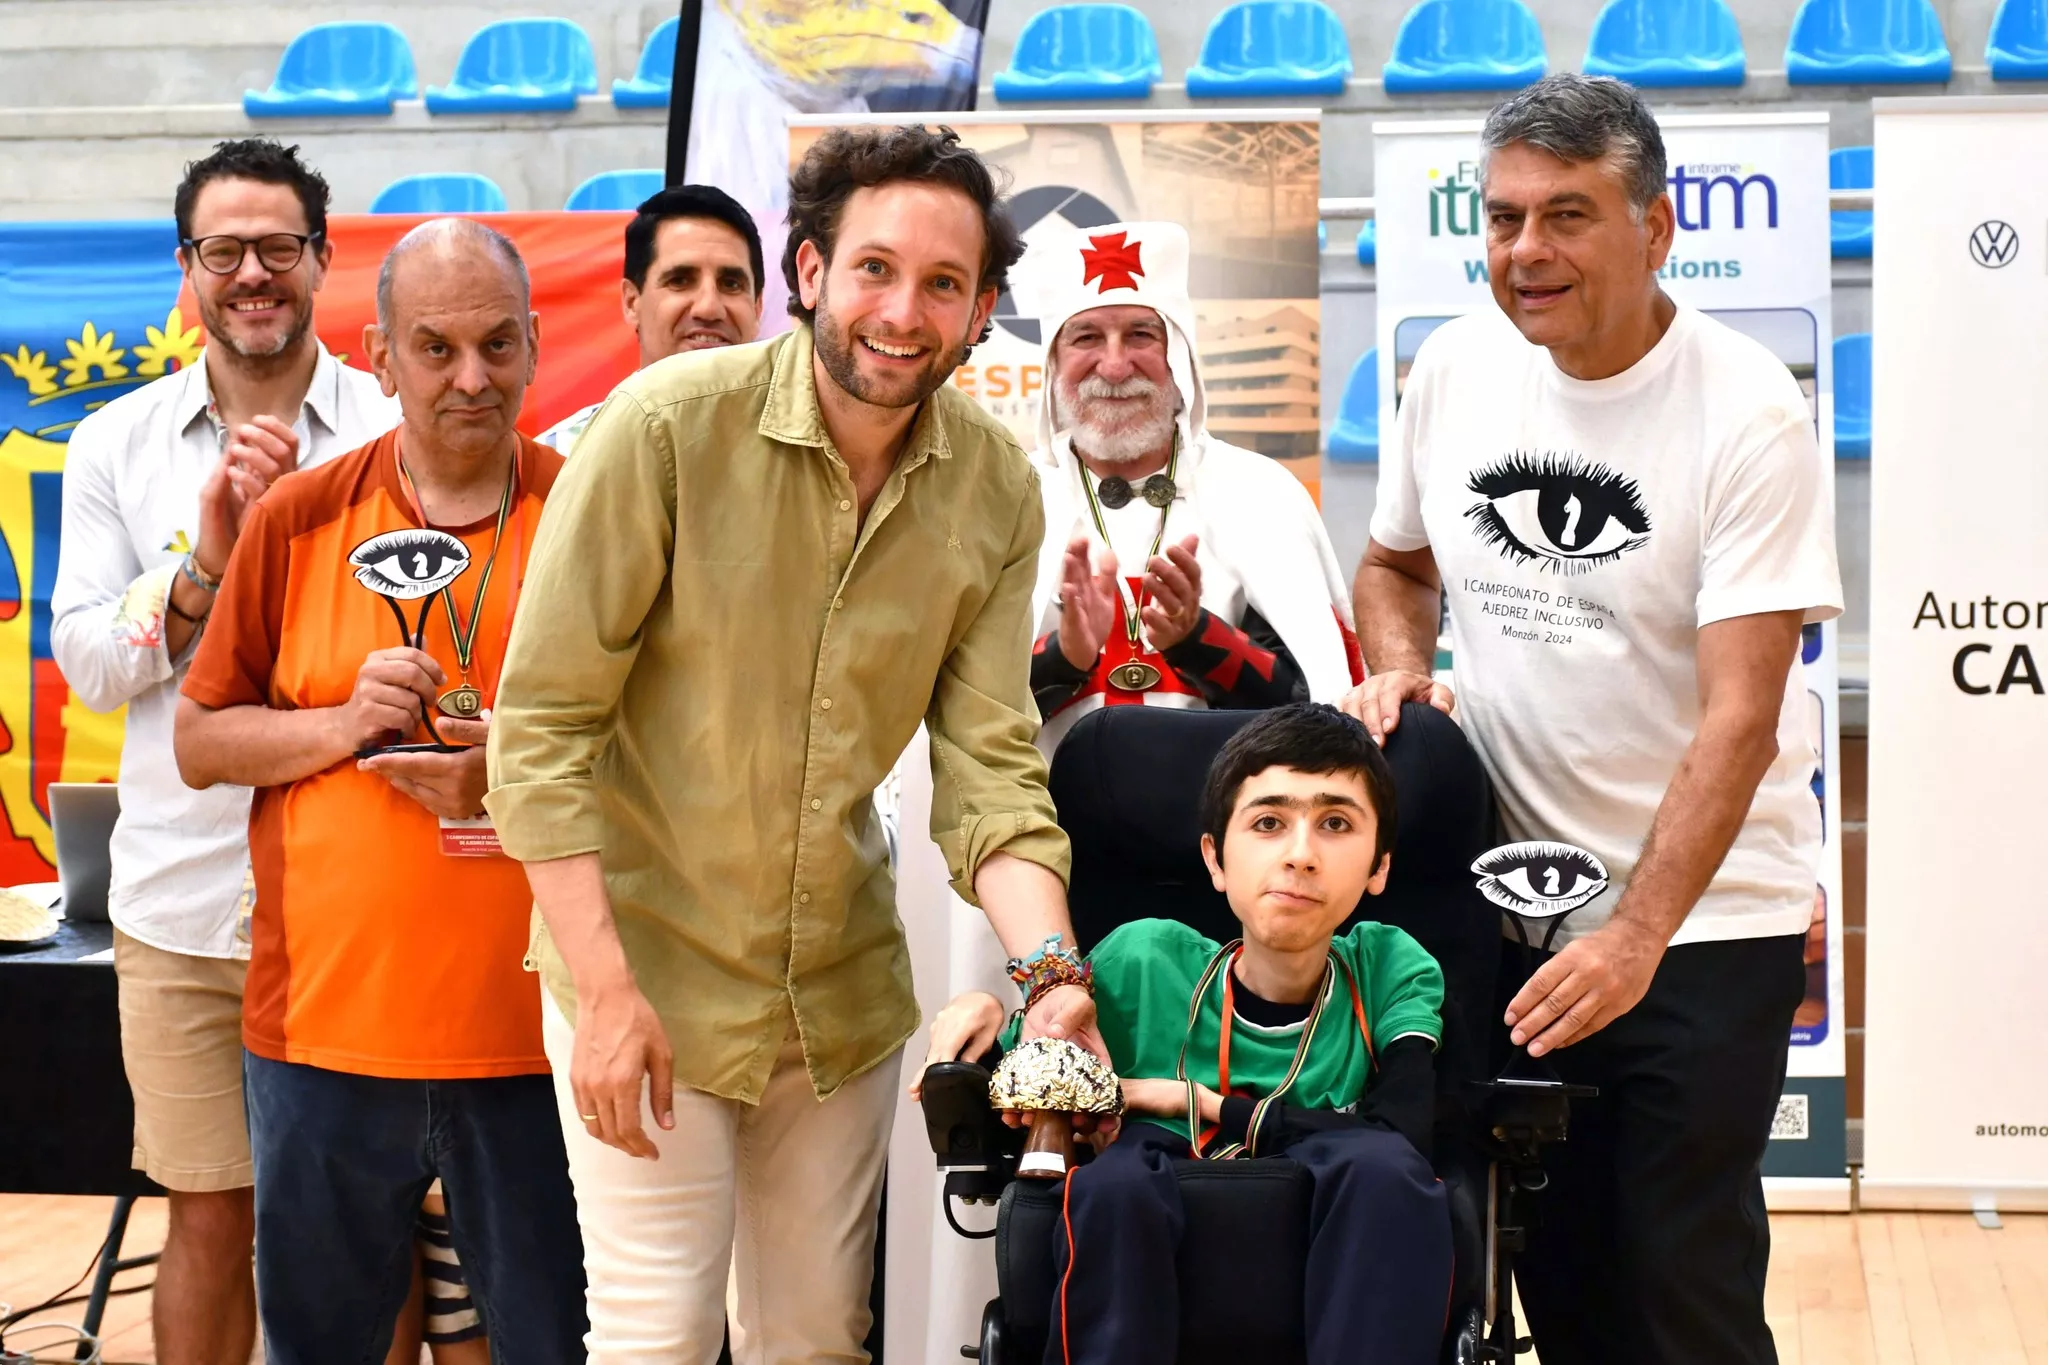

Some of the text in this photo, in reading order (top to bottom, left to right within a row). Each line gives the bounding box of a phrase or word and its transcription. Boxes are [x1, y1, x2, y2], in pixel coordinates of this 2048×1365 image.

[1667, 164, 1778, 231] tm
[1464, 578, 1468, 591] I
[1470, 579, 1550, 603] CAMPEONATO
[1556, 595, 1574, 609] DE
[1481, 601, 1604, 630] AJEDREZ INCLUSIVO
[1501, 624, 1572, 645] Monzón 2024
